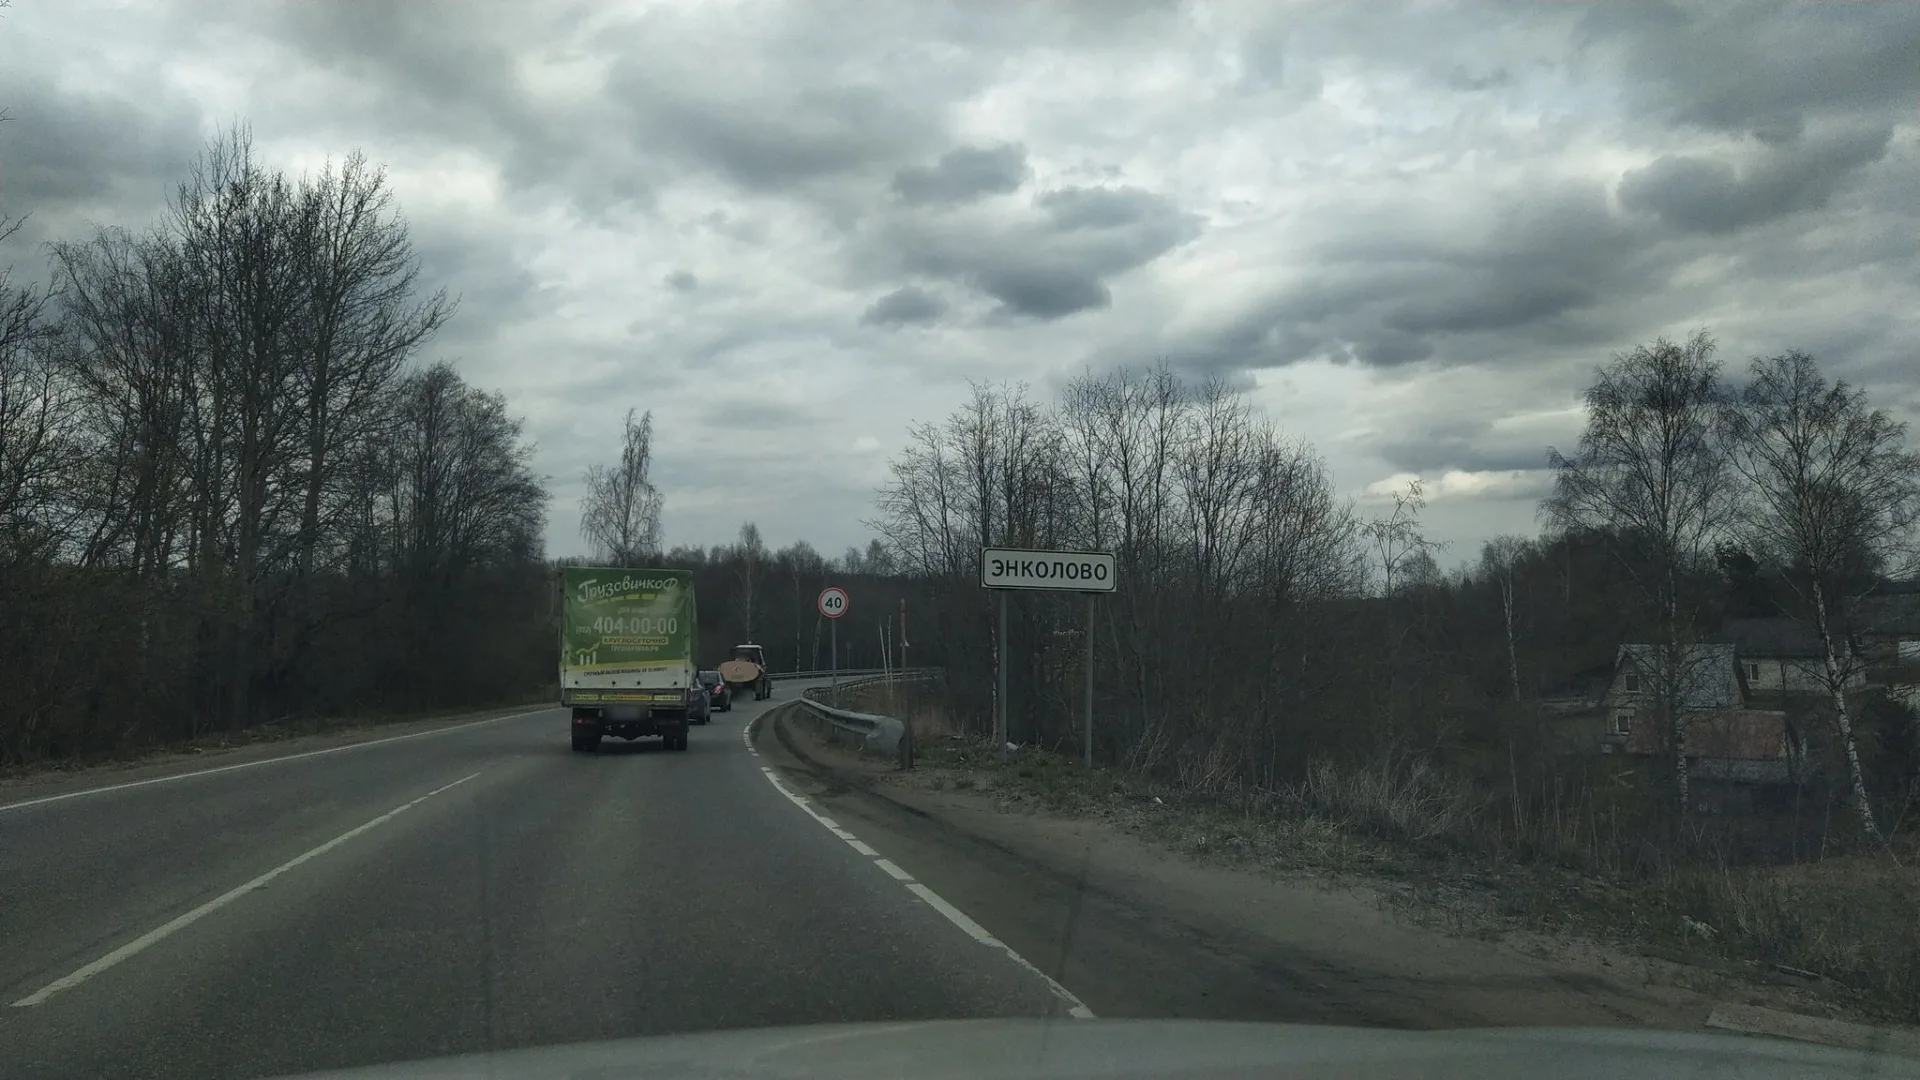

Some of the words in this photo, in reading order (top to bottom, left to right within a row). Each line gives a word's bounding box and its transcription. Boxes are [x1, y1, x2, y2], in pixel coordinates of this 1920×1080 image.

[991, 559, 1107, 581] ЭНКОЛОВО
[825, 597, 842, 609] 40
[593, 616, 677, 634] 404-00-00
[603, 636, 667, 644] КРУГЛОСУТОЧНО
